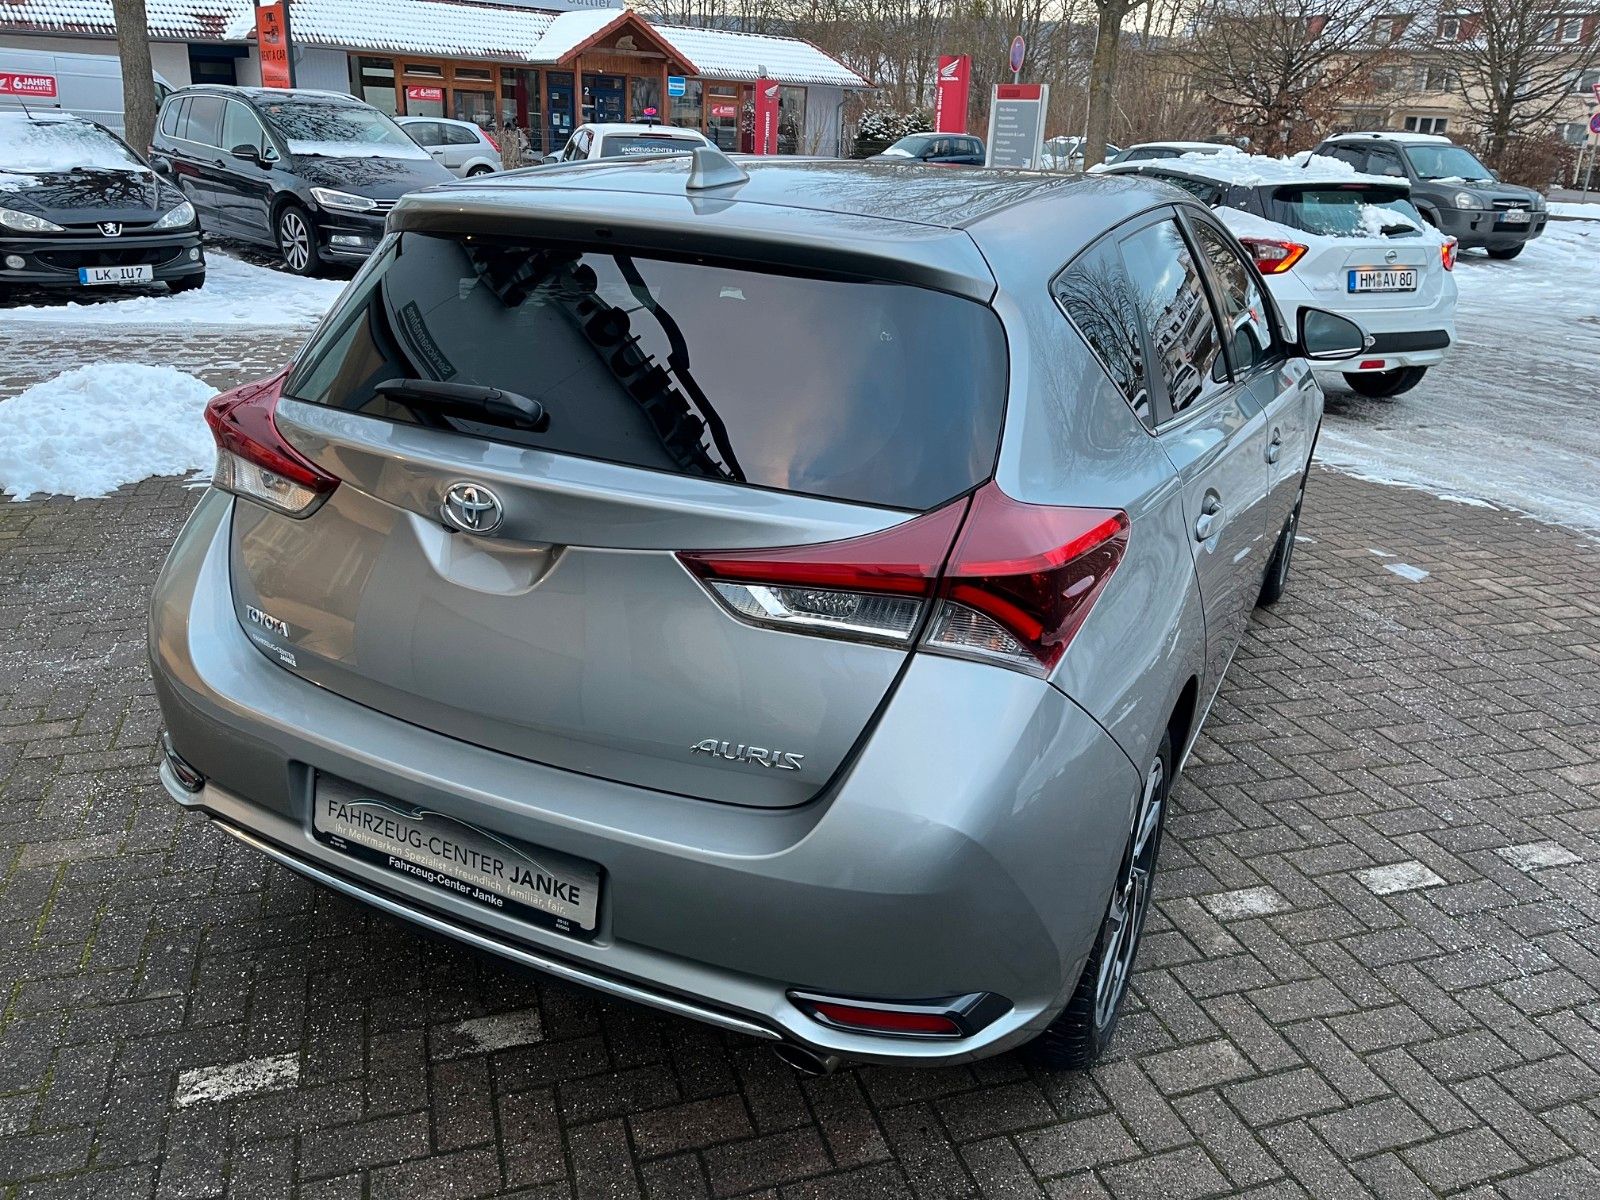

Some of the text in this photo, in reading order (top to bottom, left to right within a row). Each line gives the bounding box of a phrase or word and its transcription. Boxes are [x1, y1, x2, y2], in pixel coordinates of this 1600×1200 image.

[13, 77, 52, 89] 6 JAHRE
[584, 86, 590, 96] 2
[95, 269, 111, 281] LK
[1360, 272, 1412, 288] HM AV 80
[245, 604, 289, 638] TOYOTA
[690, 738, 805, 771] AURIS
[327, 799, 580, 906] FAHRZEUG-CENTER JANKE
[335, 823, 346, 834] Ihr
[348, 827, 402, 856] Mehrmarken
[404, 848, 447, 873] Spezialist
[547, 899, 566, 915] fair.
[389, 856, 503, 907] Fahrzeug-Center Janke
